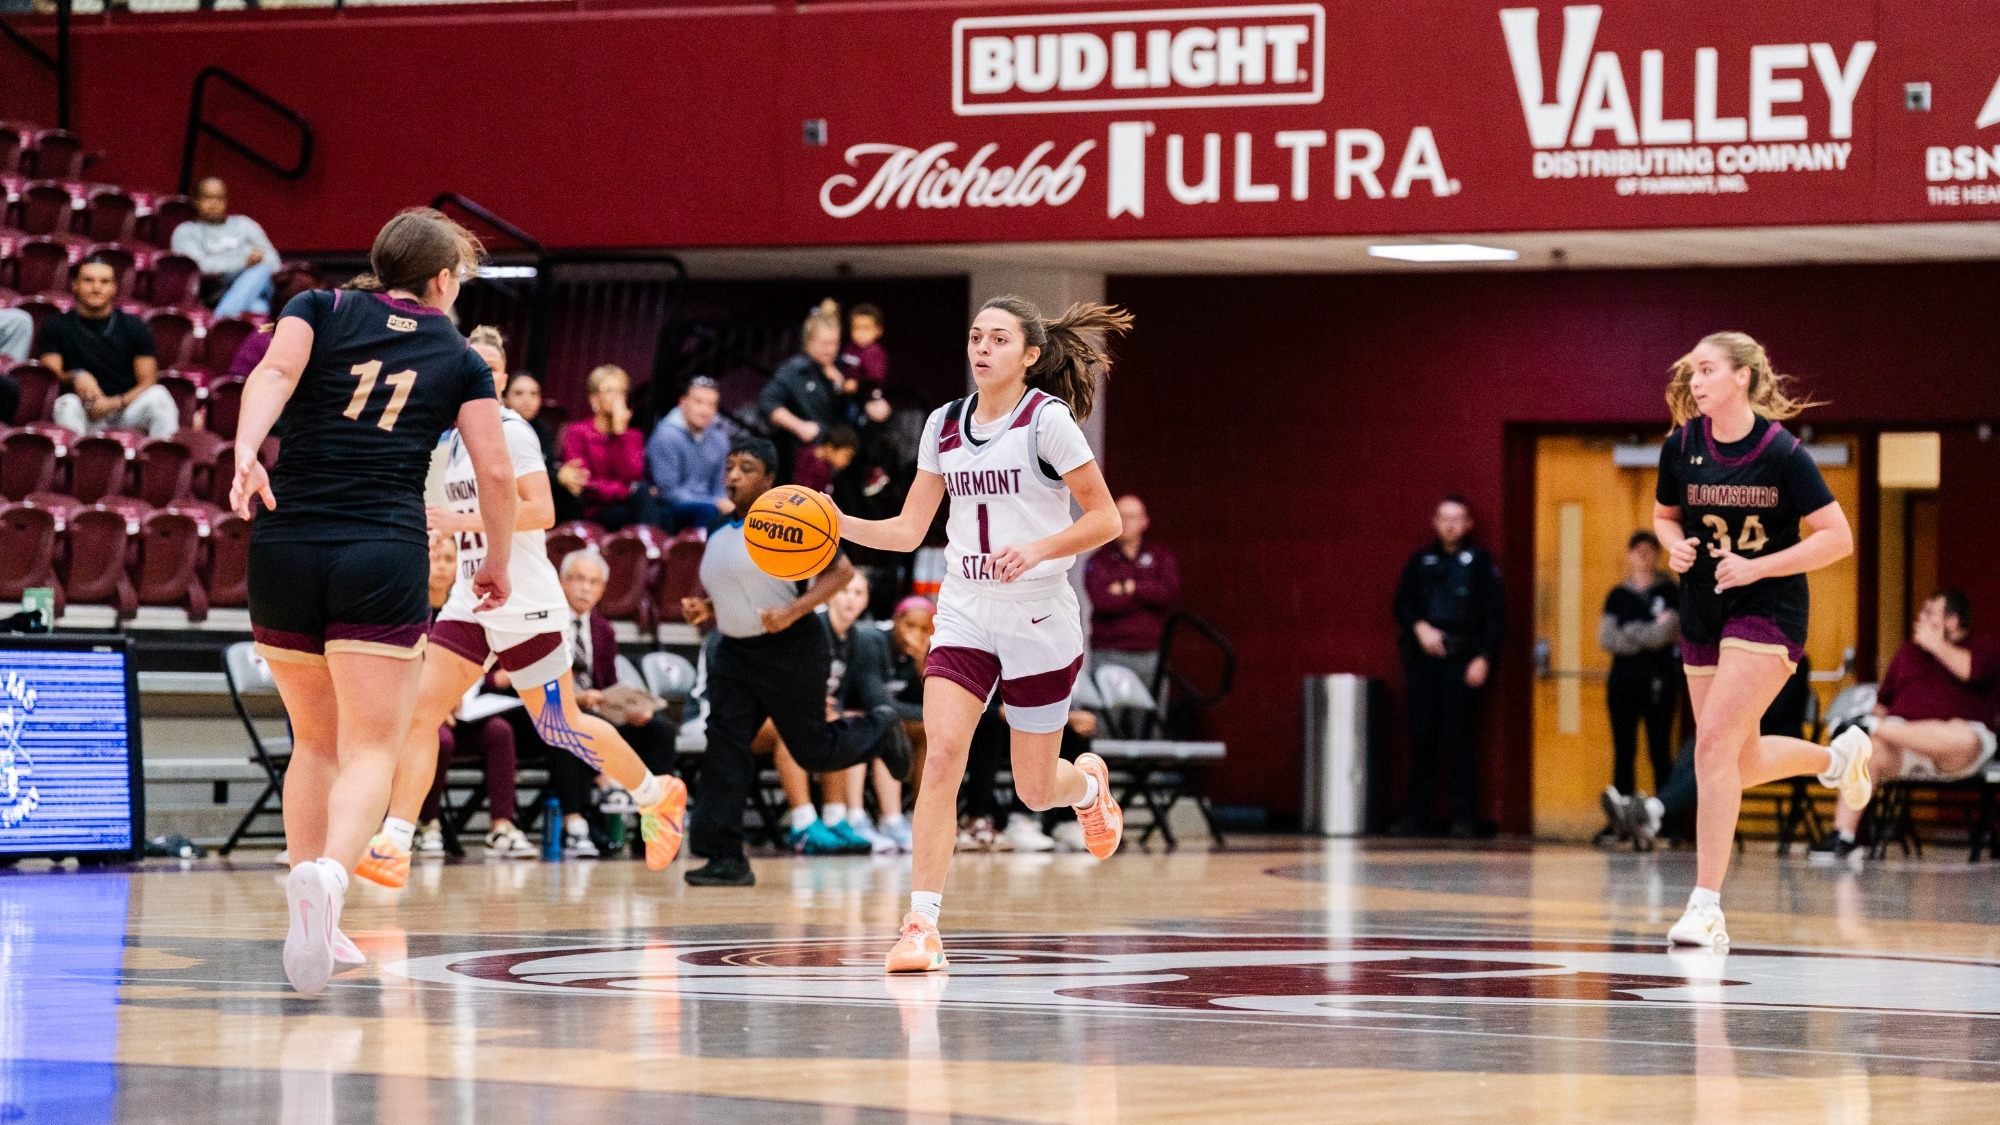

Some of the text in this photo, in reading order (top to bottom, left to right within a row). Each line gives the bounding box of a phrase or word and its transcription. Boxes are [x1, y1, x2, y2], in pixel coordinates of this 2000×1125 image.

[969, 34, 1108, 94] BUD
[1500, 5, 1876, 149] VALLEY
[820, 139, 1096, 218] Michelob
[1533, 142, 1852, 179] DISTRIBUTING COMPANY
[1925, 145, 2000, 182] BSN
[1926, 184, 2000, 206] THE HEA
[343, 359, 417, 432] 11
[943, 469, 1021, 497] AIRMONT
[1687, 484, 1779, 508] BLOOMSBURG
[749, 517, 804, 545] Wilson
[976, 502, 991, 554] 1
[1702, 514, 1769, 558] 34
